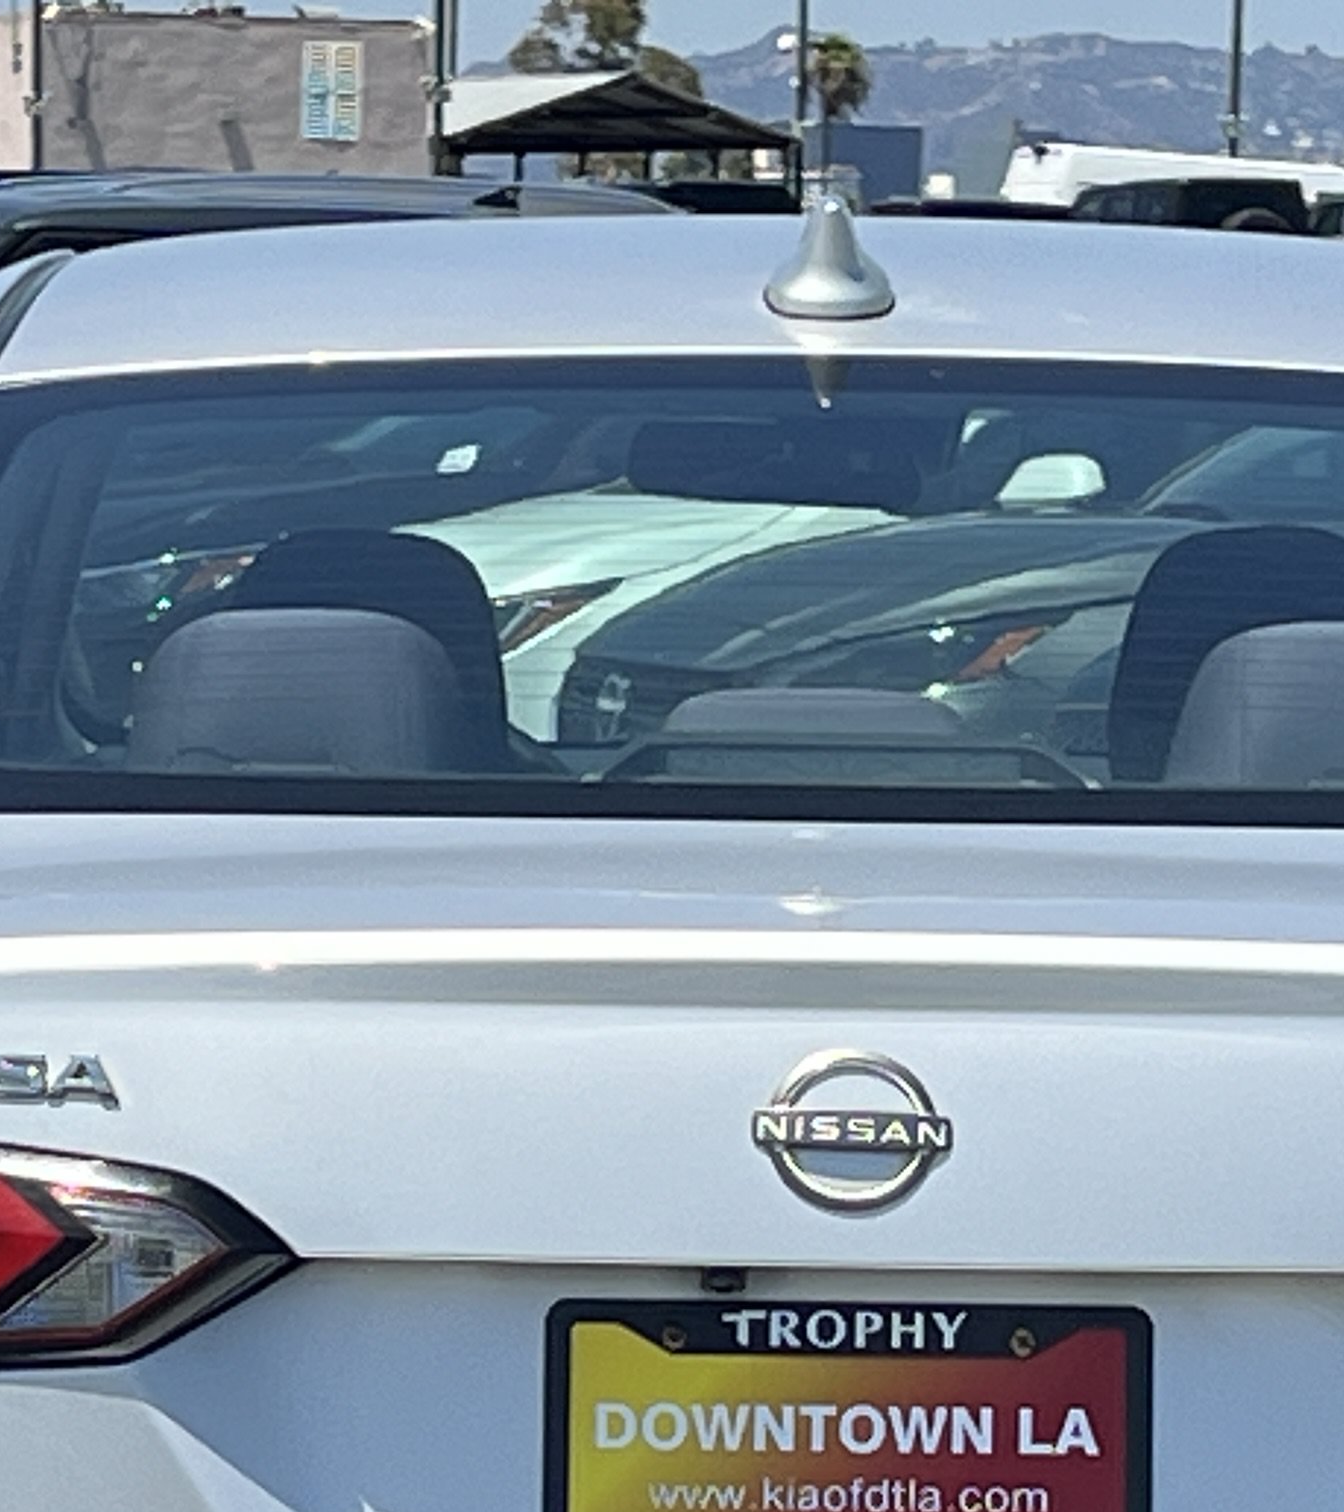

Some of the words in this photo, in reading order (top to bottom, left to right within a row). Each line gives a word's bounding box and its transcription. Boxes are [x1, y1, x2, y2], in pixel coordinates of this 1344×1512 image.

[756, 1115, 948, 1148] NISSAN
[721, 1309, 968, 1350] TROPHY
[593, 1401, 993, 1454] DOWNTOWN
[1018, 1407, 1100, 1457] LA
